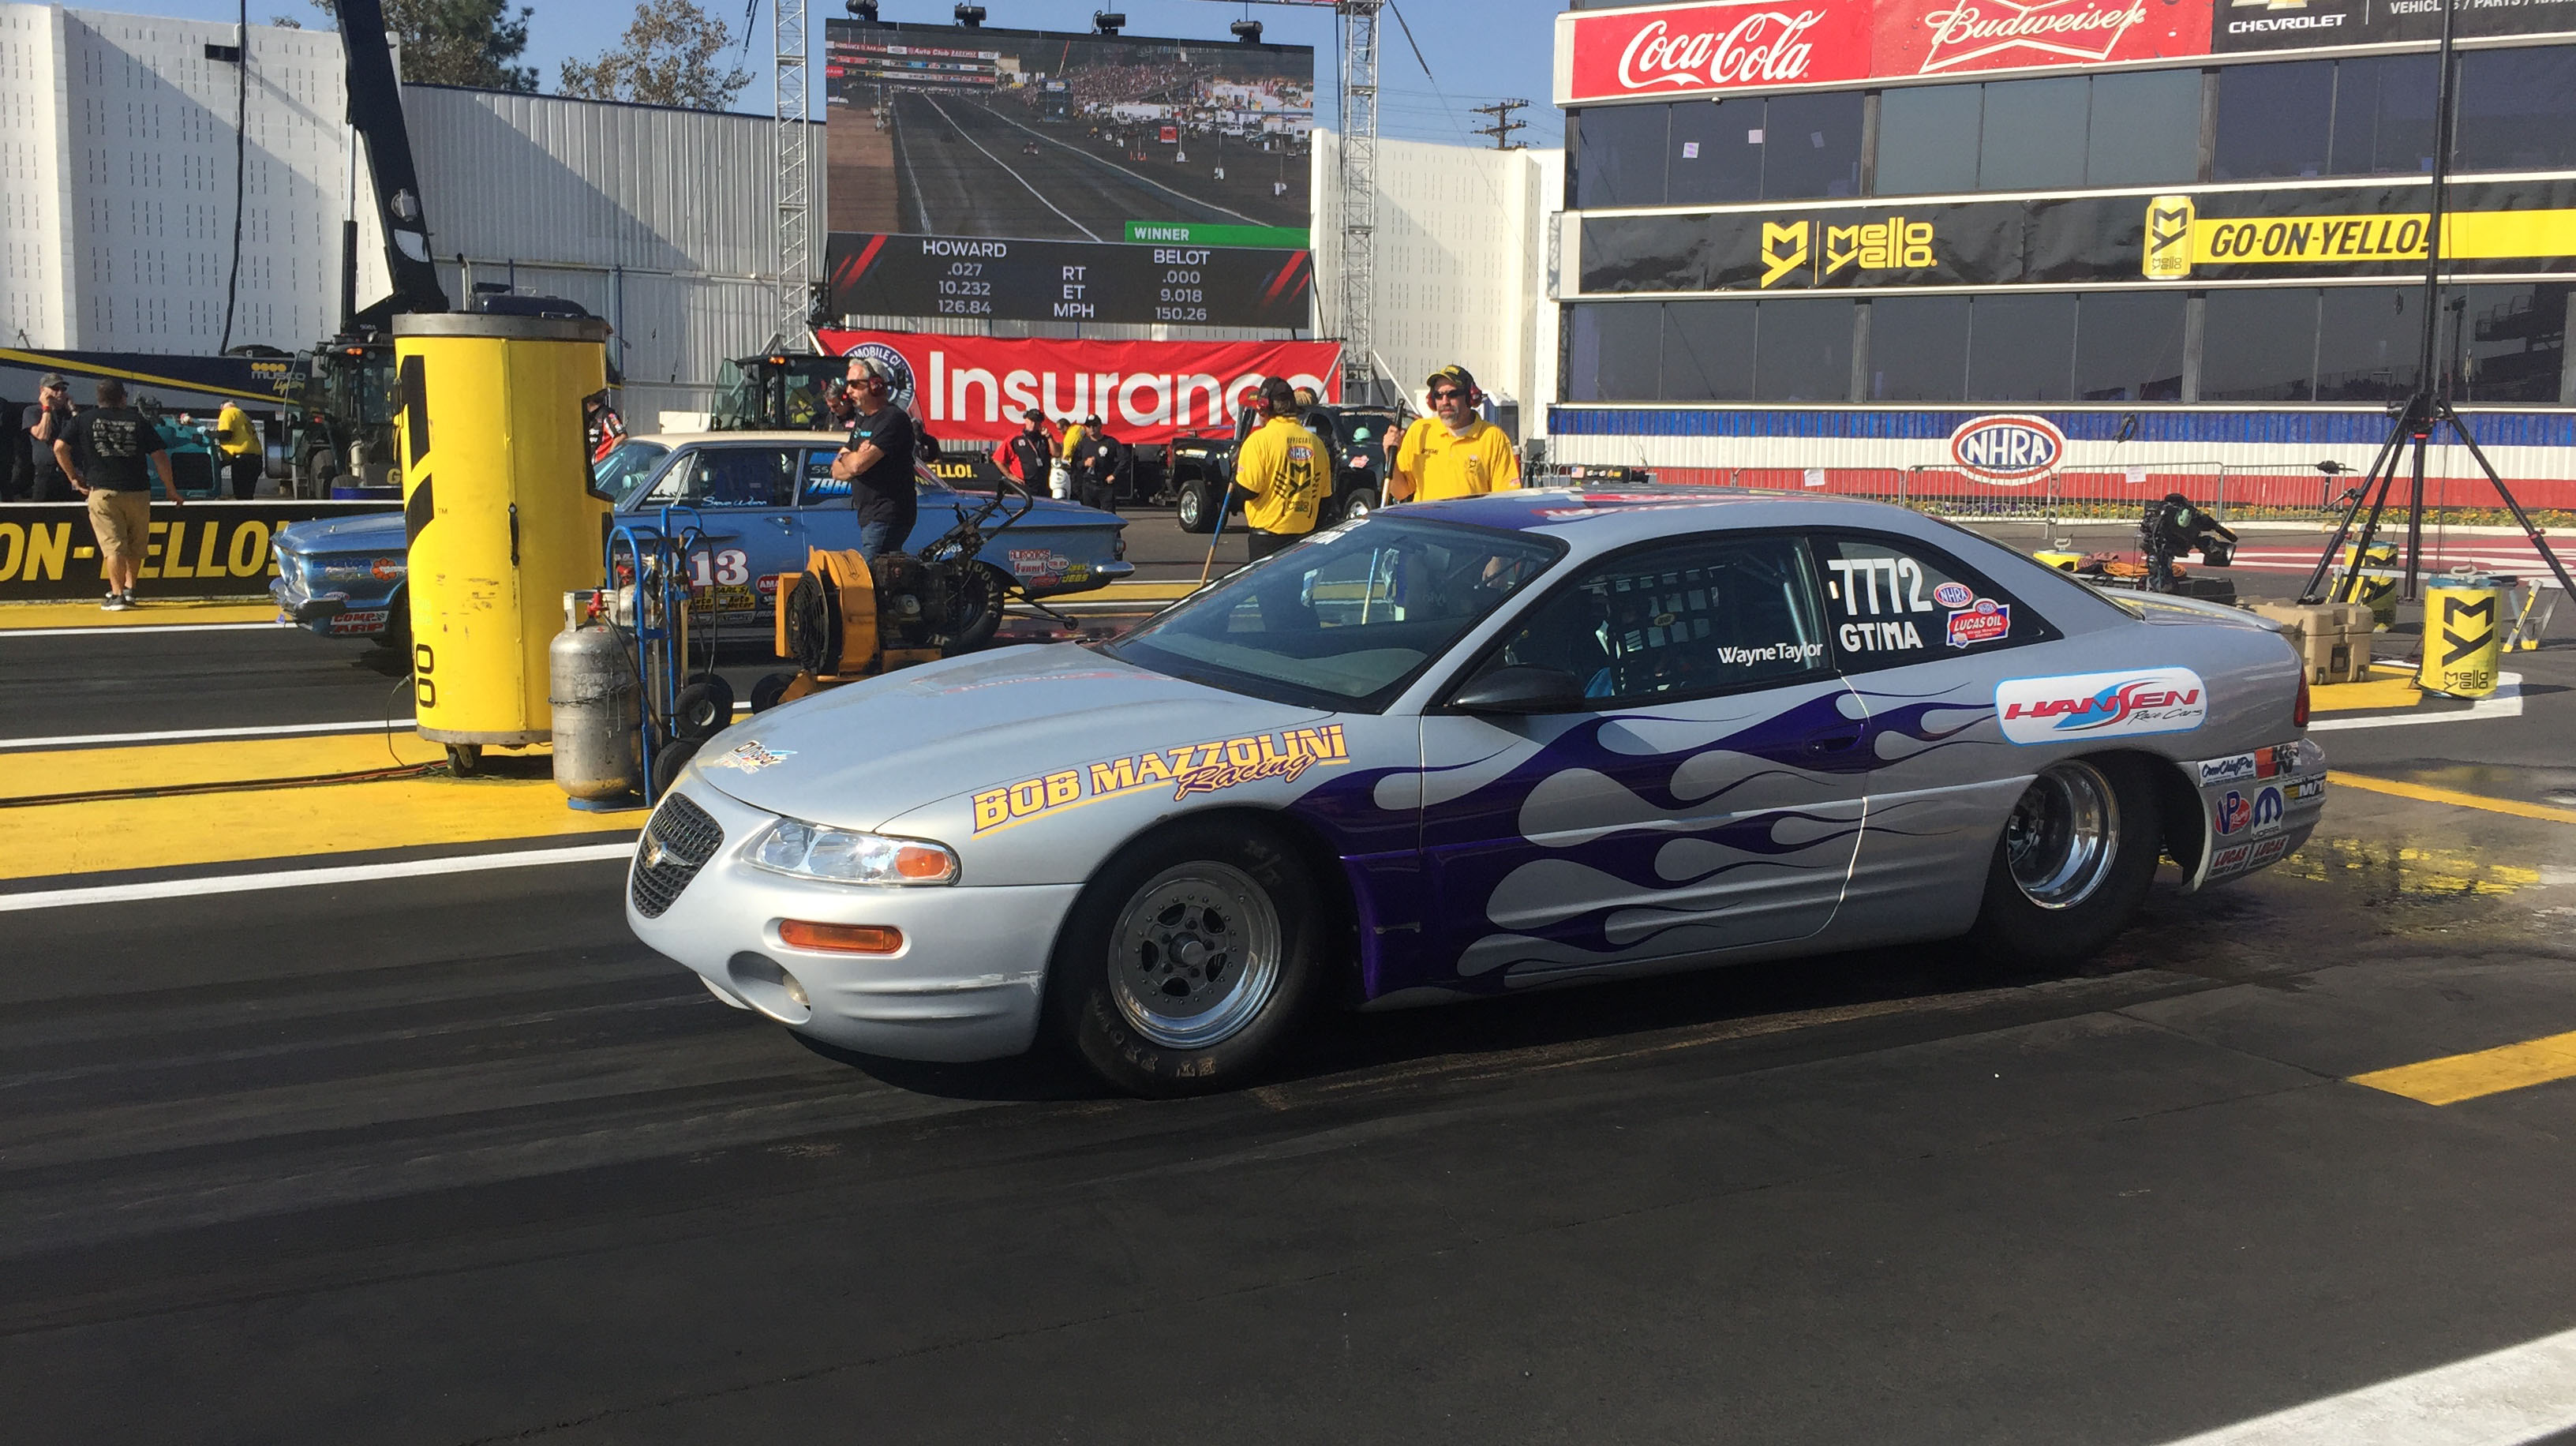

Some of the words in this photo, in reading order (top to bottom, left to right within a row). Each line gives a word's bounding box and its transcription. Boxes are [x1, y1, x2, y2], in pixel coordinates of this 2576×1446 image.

[2391, 0, 2461, 15] VEHICLS
[1924, 2, 2147, 45] Budweiser
[2229, 13, 2347, 33] CHEVROLET
[1618, 9, 1828, 88] Coca-Cola
[1133, 227, 1190, 242] WINNER
[922, 241, 1008, 259] HOWARD
[1154, 249, 1211, 265] BELOT
[947, 263, 983, 277] .027
[1062, 266, 1087, 281] RT
[1162, 271, 1201, 284] .000
[938, 281, 991, 297] 10.232
[1062, 285, 1086, 300] ET
[1160, 288, 1204, 303] 9.018
[938, 300, 992, 315] 126.84
[1053, 303, 1095, 319] MPH
[1155, 306, 1208, 321] 150.26
[251, 371, 306, 380] musco
[1967, 429, 2047, 466] NHRA
[1827, 557, 1934, 616] 7772
[1940, 588, 1968, 603] NHRA
[1953, 616, 1986, 632] LUCAS
[1986, 614, 2002, 627] OIL
[2005, 687, 2199, 721] HANSEN
[2128, 710, 2162, 725] Race
[2162, 707, 2203, 720] Cars
[972, 770, 1080, 834] BOB
[1089, 723, 1350, 794] MAZZOLINI
[1173, 752, 1318, 802] Racing
[2298, 781, 2325, 796] M/T
[2216, 790, 2241, 834] VP
[2254, 837, 2287, 857] LUCAS
[2214, 845, 2249, 868] LUCAS
